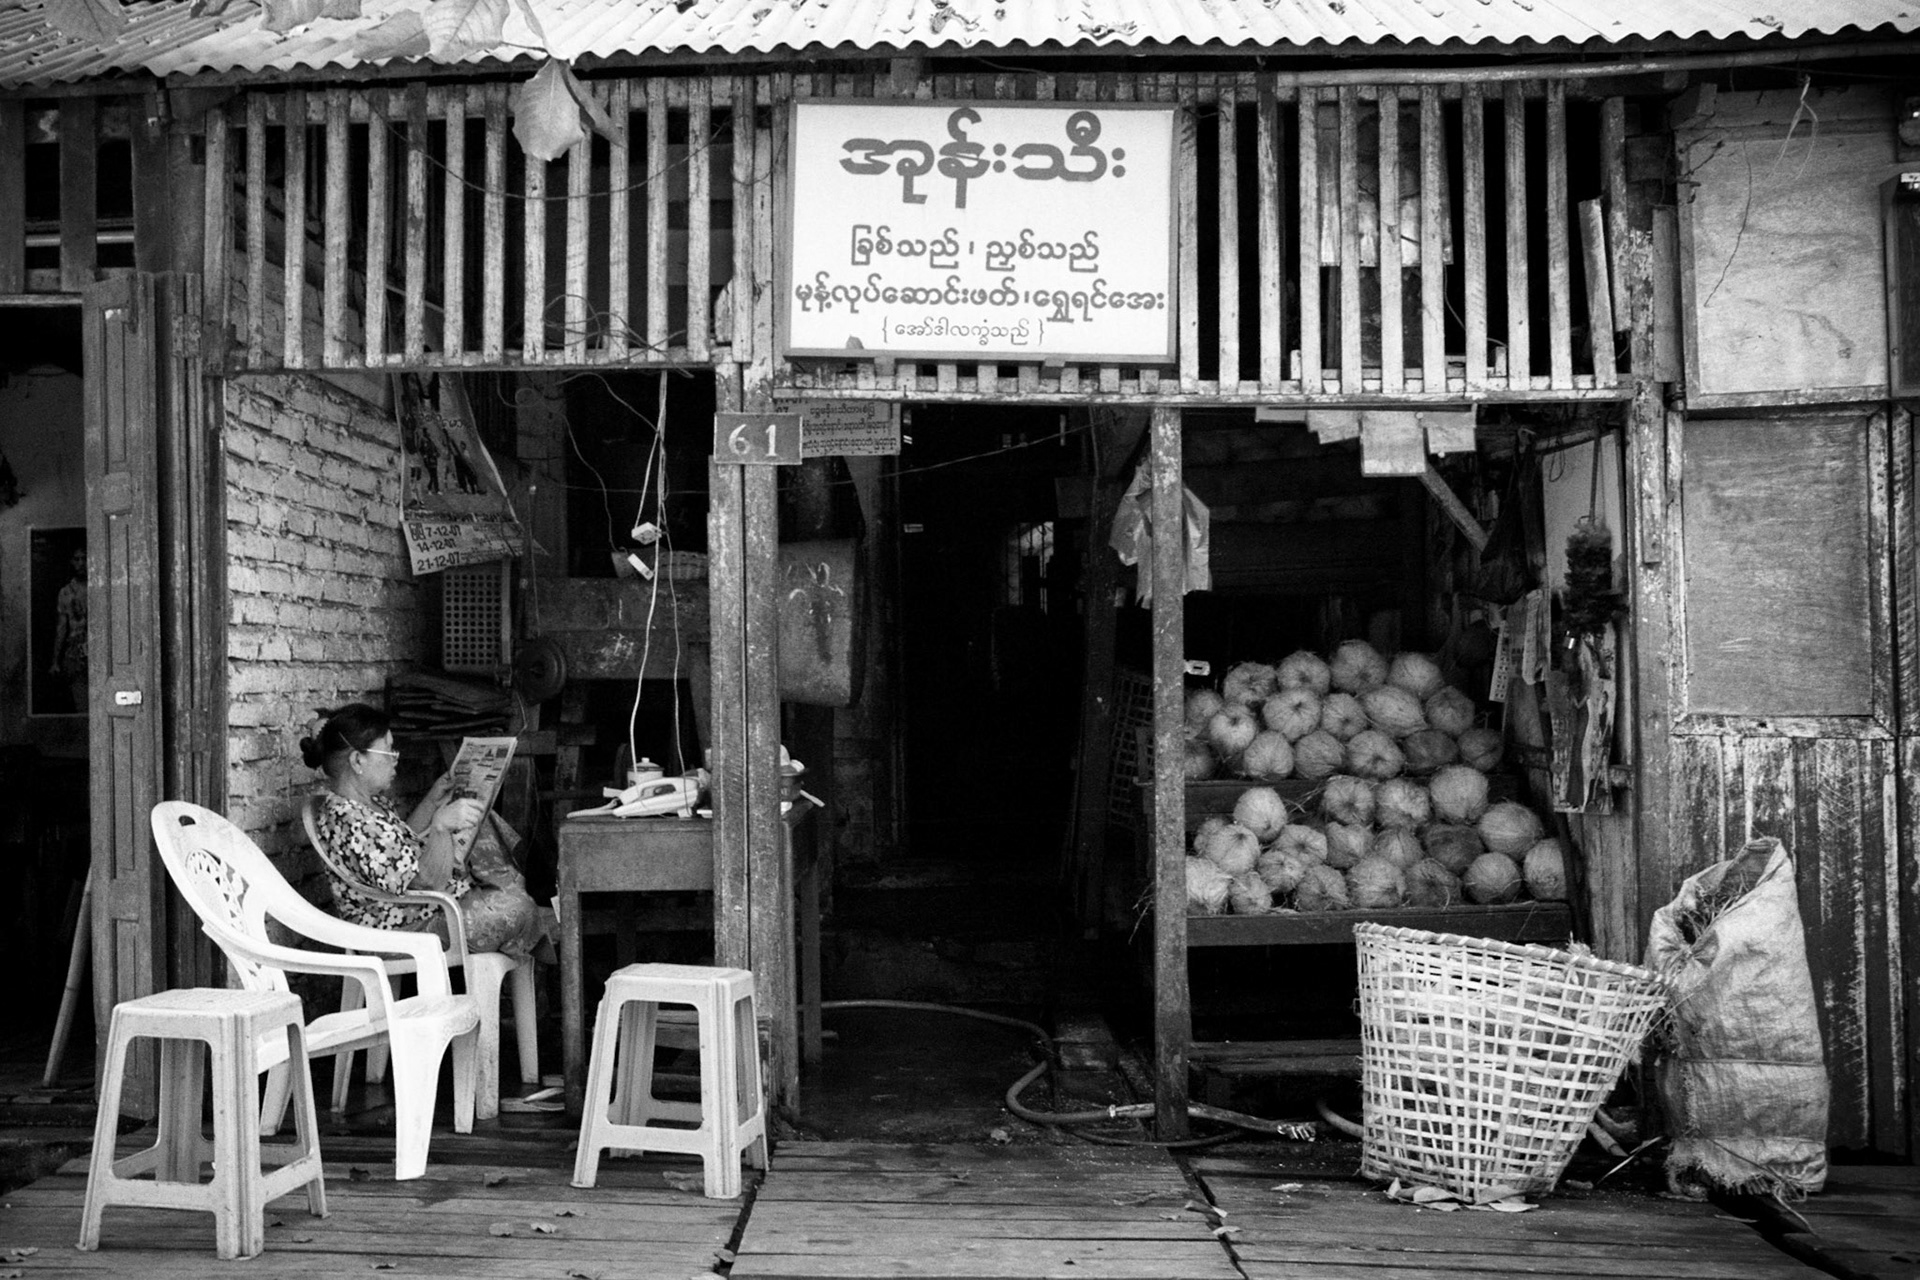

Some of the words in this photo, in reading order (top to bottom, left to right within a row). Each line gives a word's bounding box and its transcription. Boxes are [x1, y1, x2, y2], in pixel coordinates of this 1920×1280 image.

[839, 108, 1126, 209] အုန်းသီး
[728, 423, 778, 457] 61
[425, 524, 462, 538] 7-12-07
[416, 538, 458, 553] 14-12-07
[416, 552, 460, 572] 21-12-07
